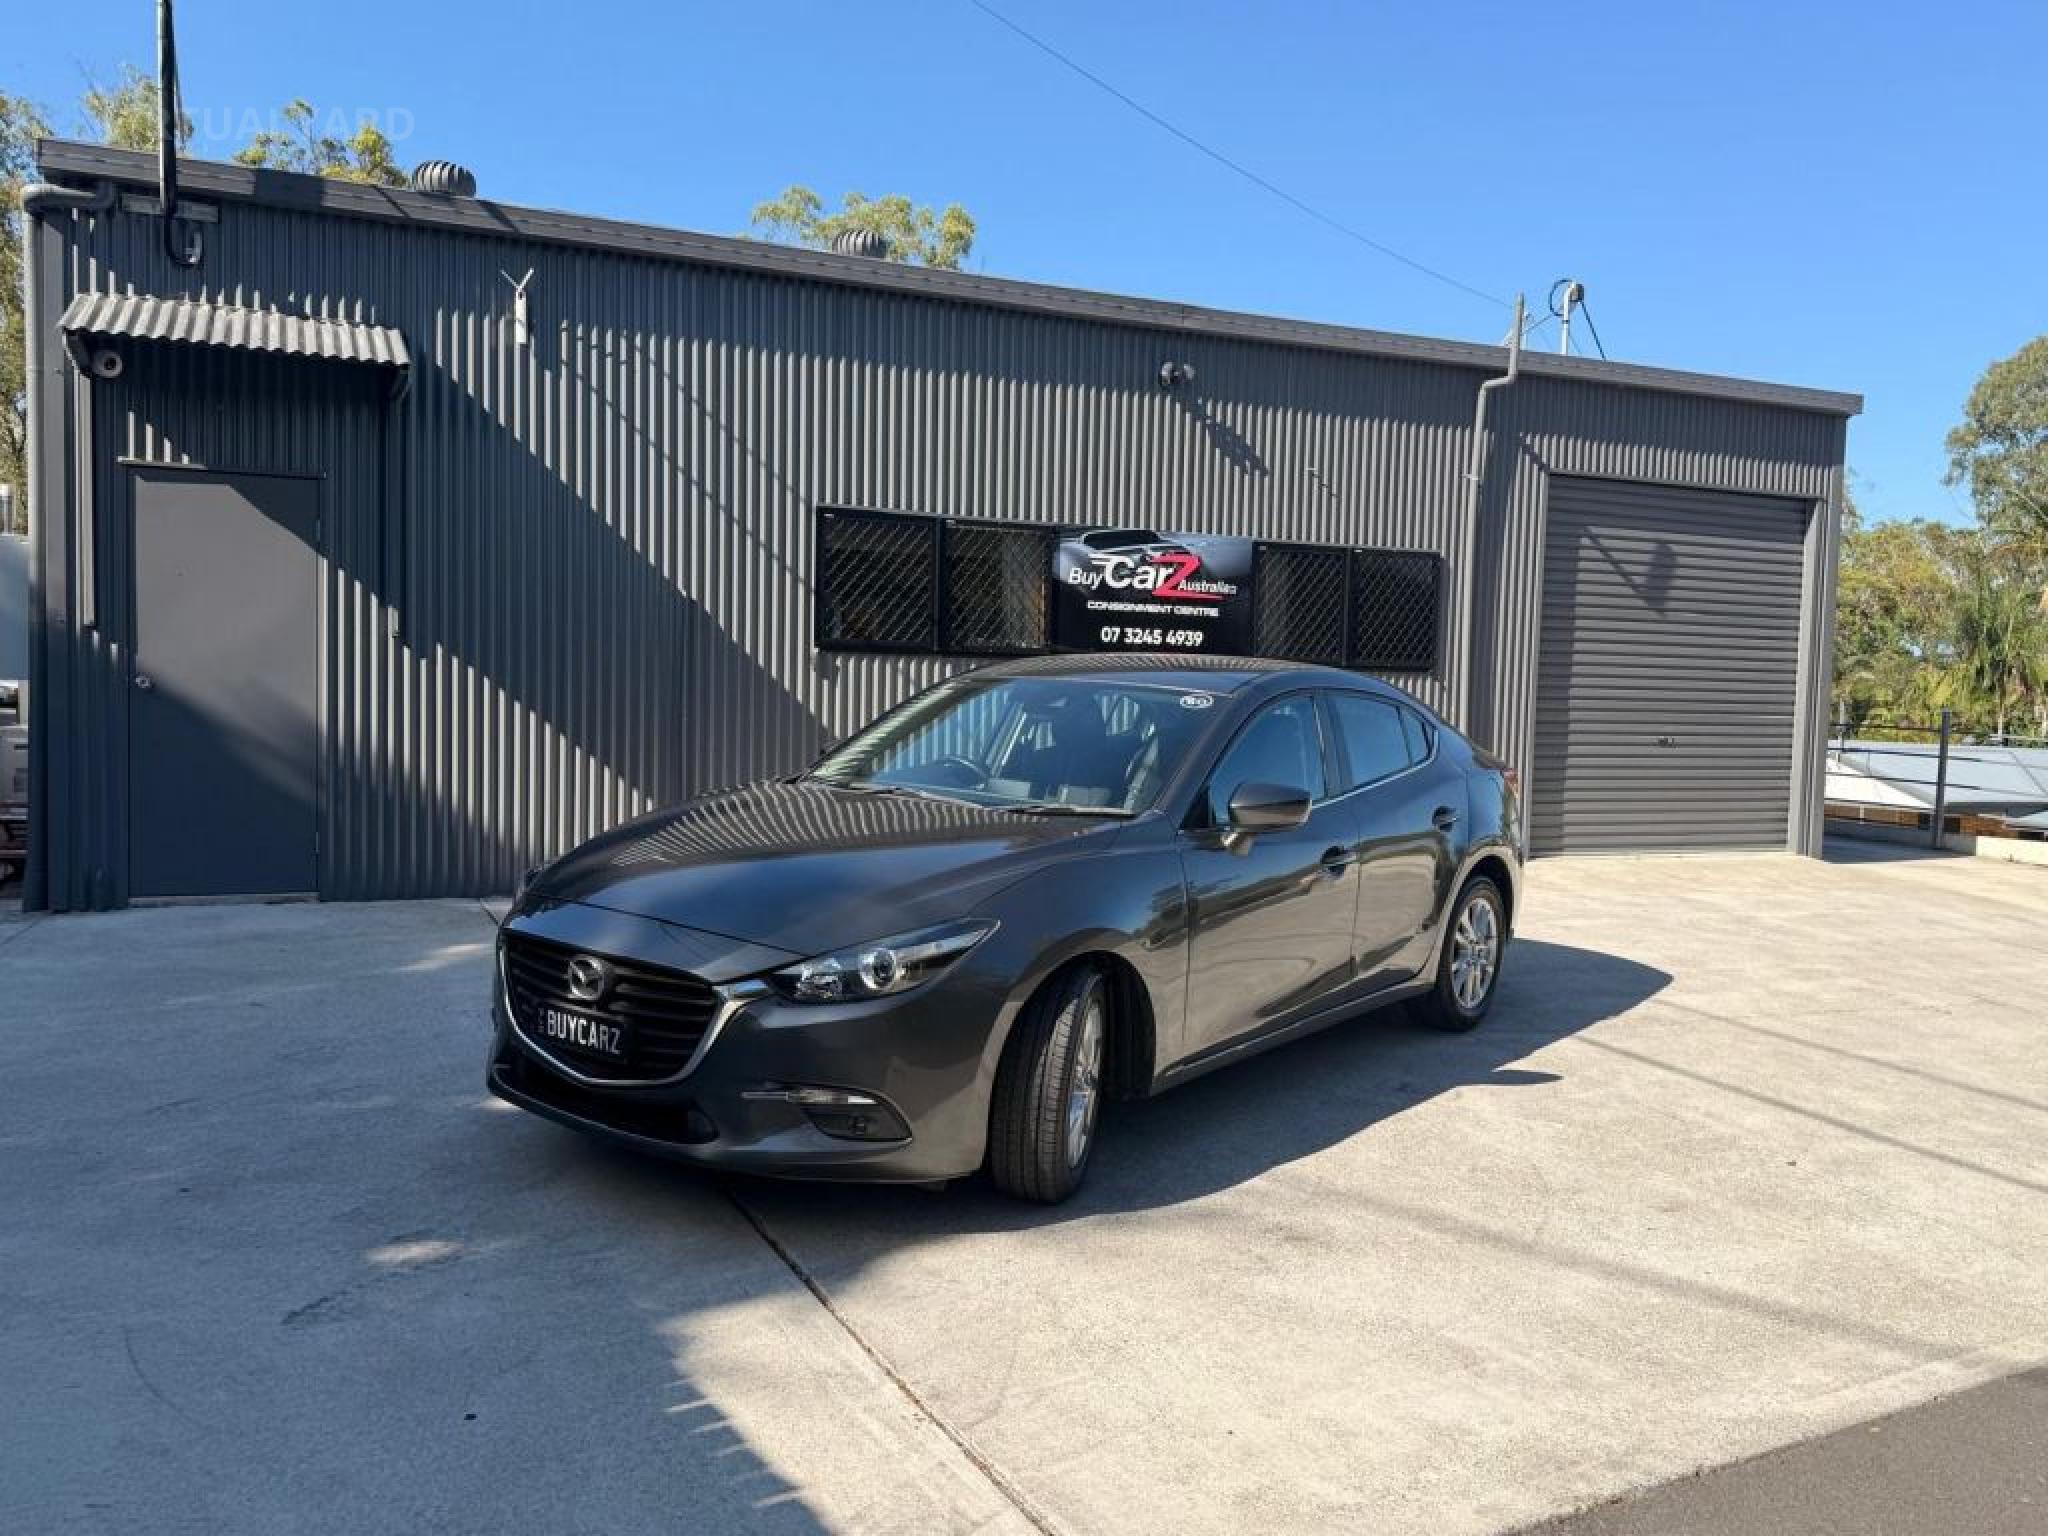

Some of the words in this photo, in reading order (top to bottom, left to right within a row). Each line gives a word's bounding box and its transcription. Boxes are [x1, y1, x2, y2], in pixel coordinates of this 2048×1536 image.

[1068, 567, 1102, 590] Buy
[1087, 600, 1171, 614] CONSIGNMENT
[1173, 606, 1219, 617] CENTRE
[1101, 626, 1120, 642] 07
[1124, 627, 1162, 645] 3245
[1165, 629, 1203, 647] 4939
[547, 1009, 620, 1054] BUYCARZ
